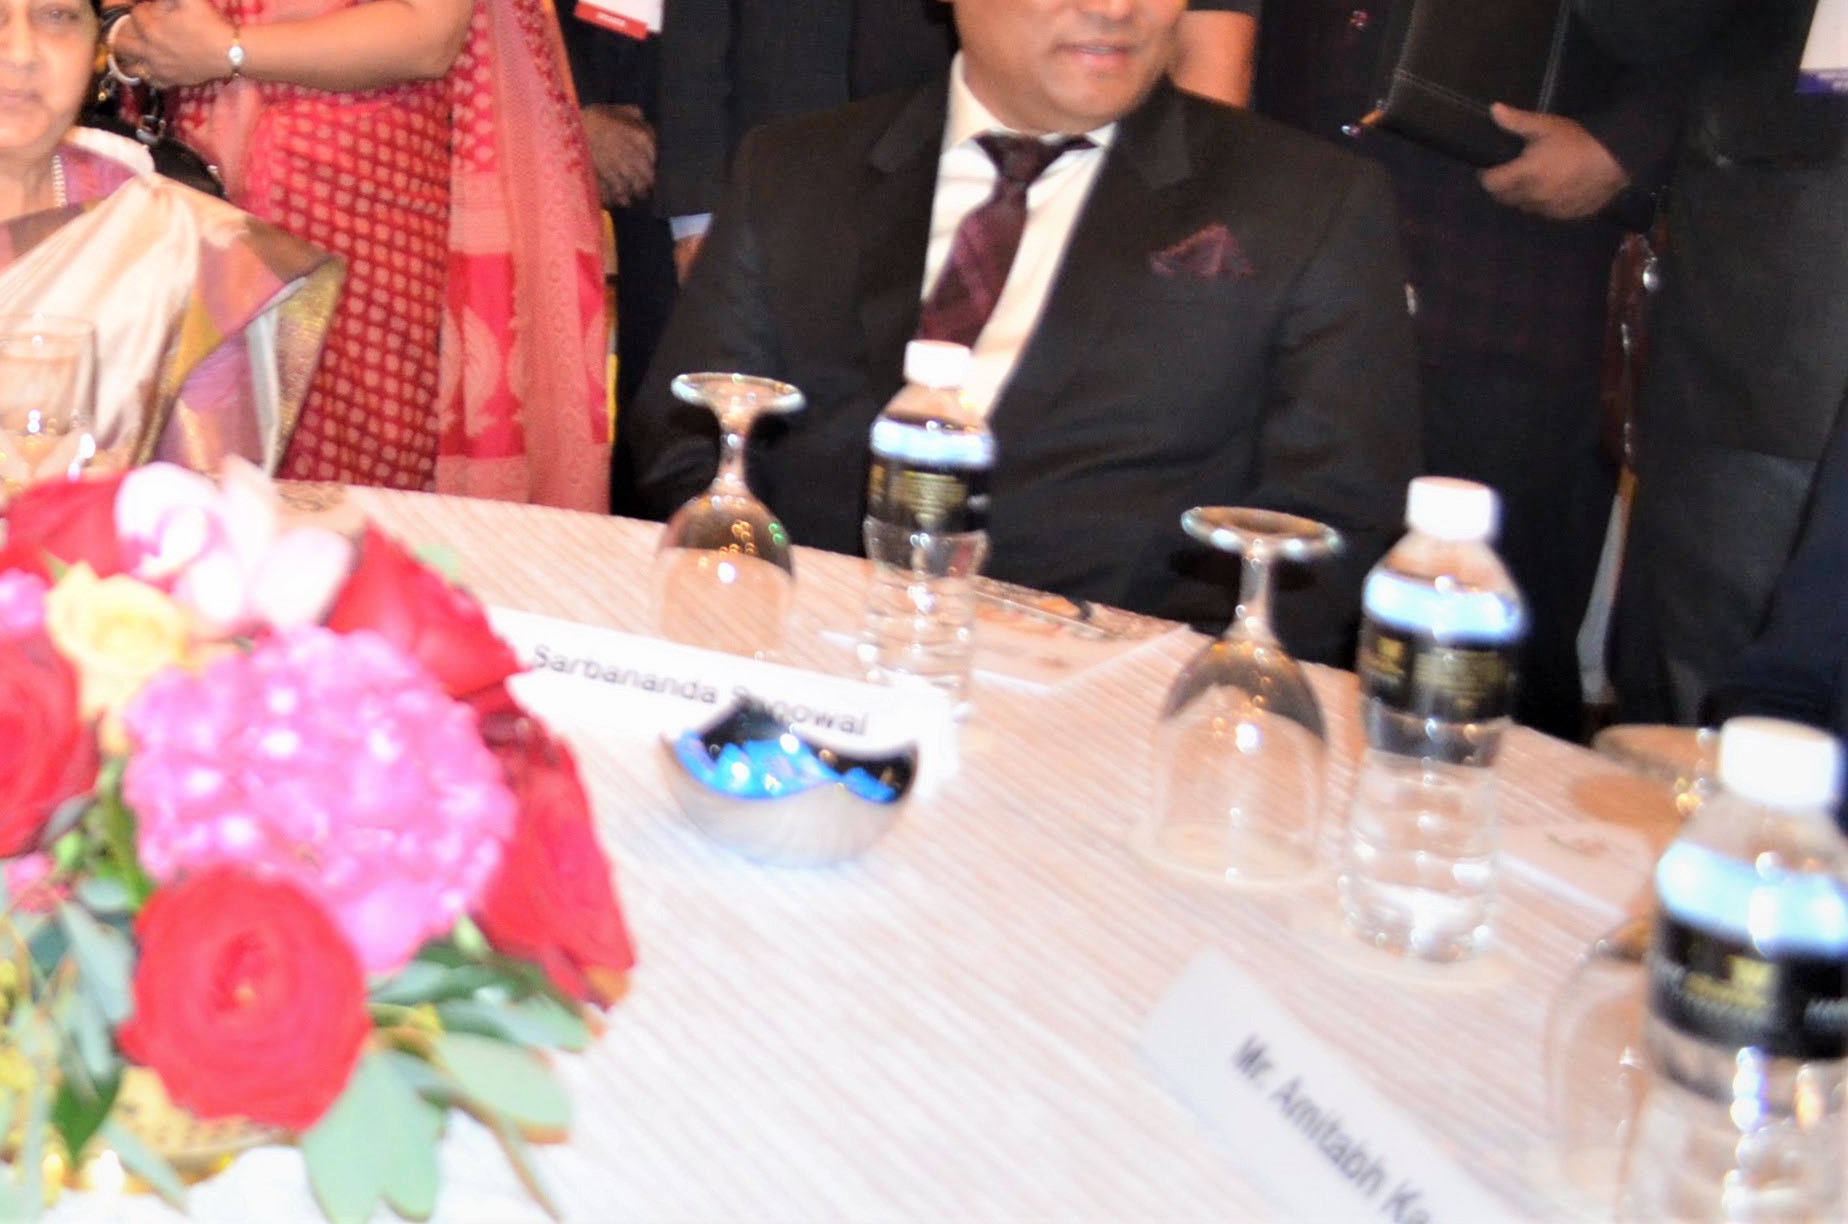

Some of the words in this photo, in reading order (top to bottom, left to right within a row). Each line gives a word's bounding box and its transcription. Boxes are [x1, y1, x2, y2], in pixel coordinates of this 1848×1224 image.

[532, 643, 720, 705] Sarbananda
[1230, 1032, 1275, 1089] Mr.
[1269, 1074, 1389, 1197] Amitabh
